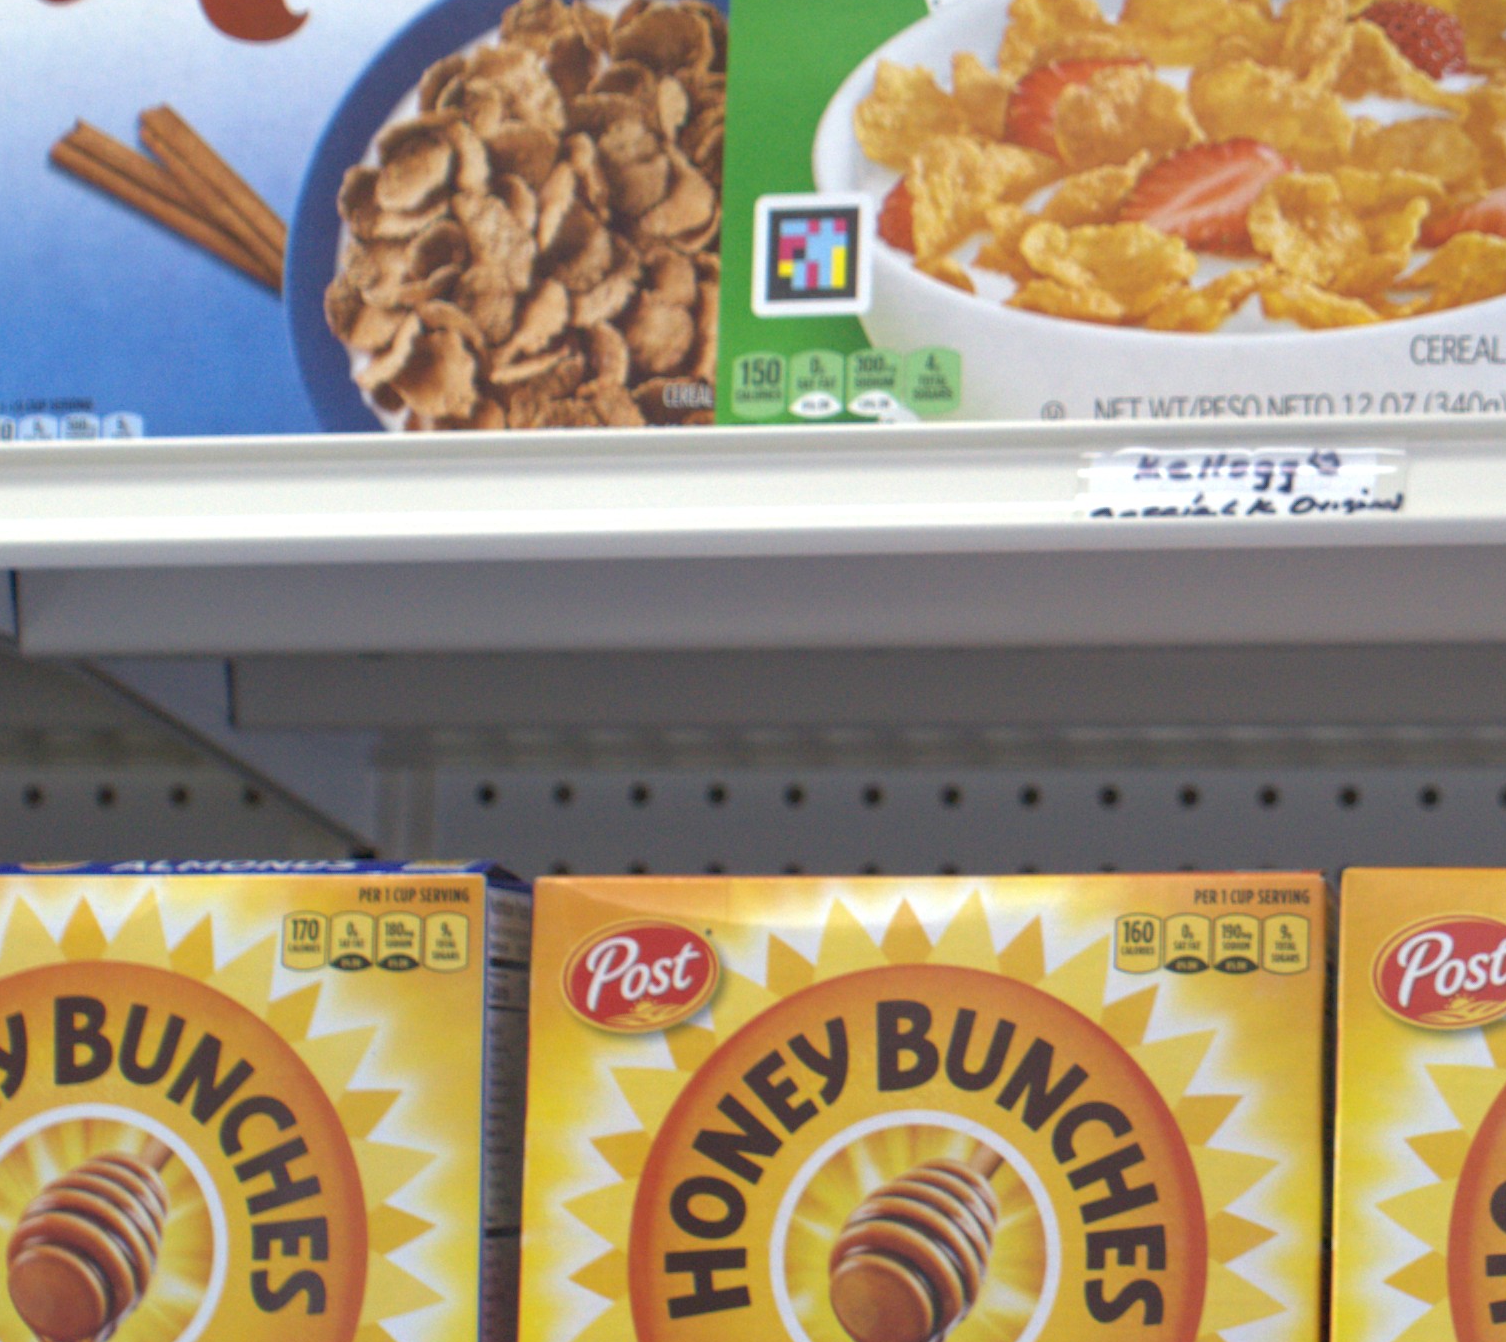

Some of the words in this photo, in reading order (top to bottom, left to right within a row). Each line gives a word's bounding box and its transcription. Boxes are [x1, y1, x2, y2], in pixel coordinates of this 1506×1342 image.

[585, 935, 700, 1012] Post
[52, 994, 330, 1317] BUNCHES
[663, 1015, 850, 1320] HONEY
[875, 999, 1168, 1327] BUNCHES
